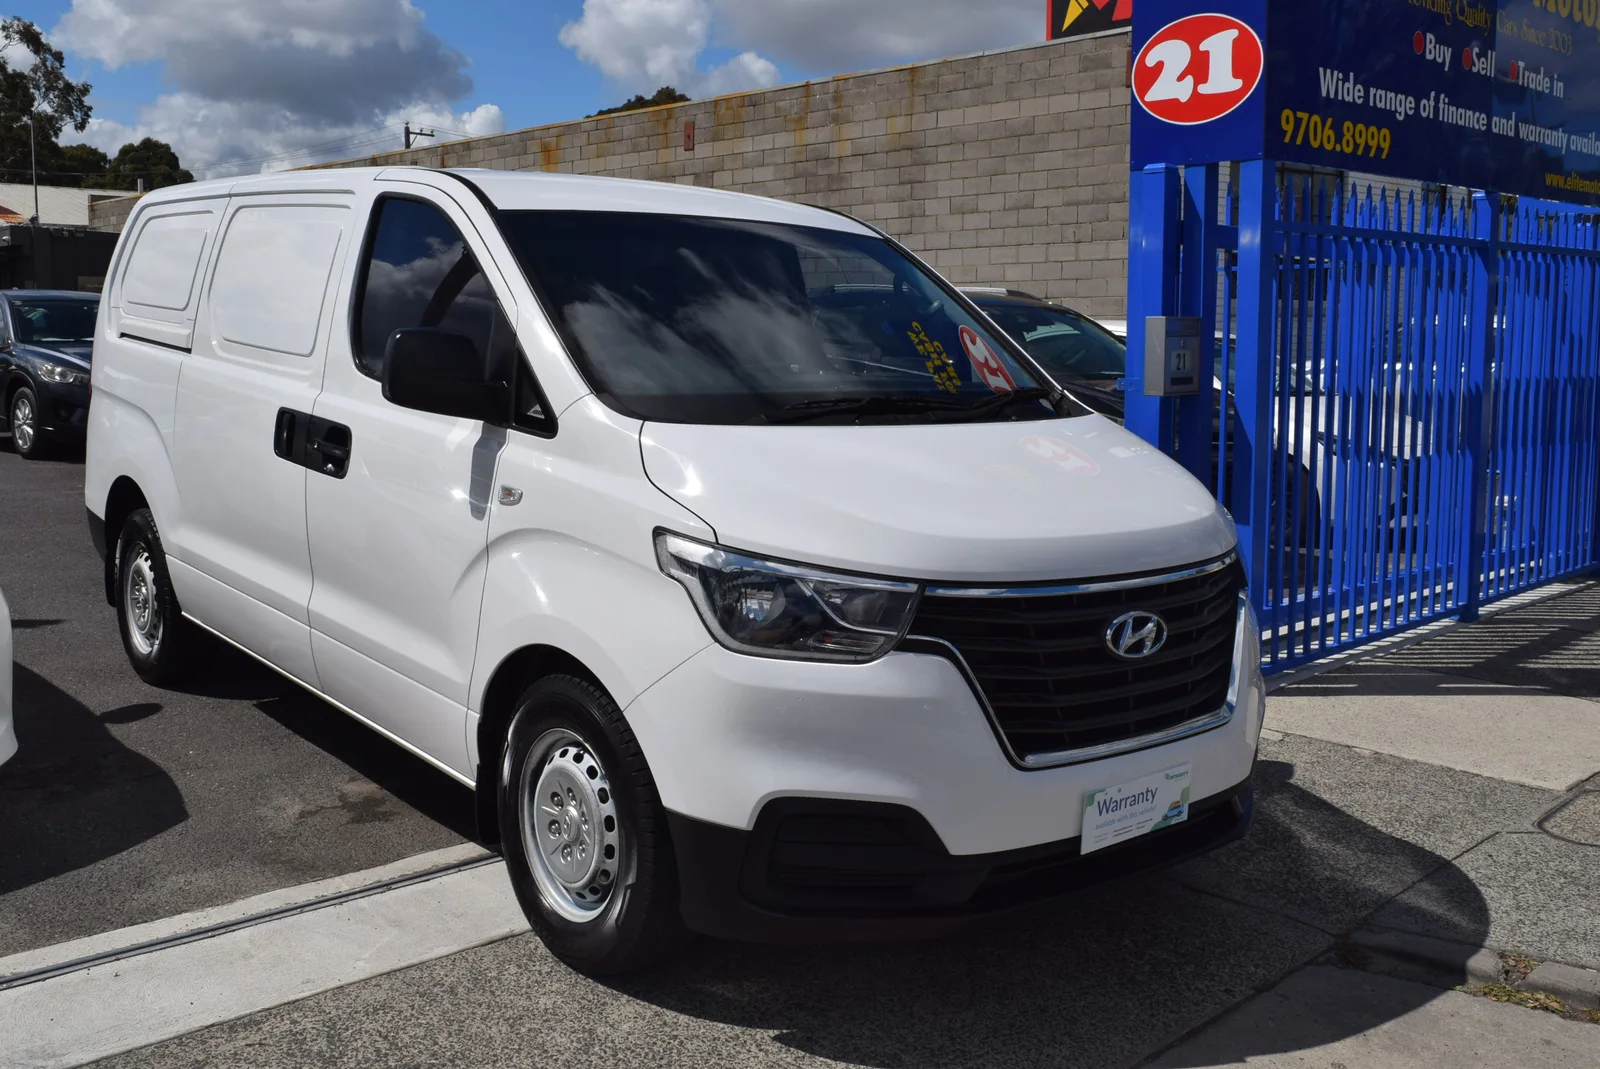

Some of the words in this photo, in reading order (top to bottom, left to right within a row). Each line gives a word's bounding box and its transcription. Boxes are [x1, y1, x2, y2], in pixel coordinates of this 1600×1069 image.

[1456, 0, 1492, 36] Quality
[1496, 9, 1518, 38] Cars
[1521, 18, 1546, 47] Since
[1549, 28, 1573, 55] 2003
[1144, 28, 1243, 102] 21
[1425, 33, 1452, 71] Buy
[1472, 46, 1495, 78] Sell
[1517, 61, 1551, 94] Trade
[1553, 75, 1565, 98] in
[1281, 109, 1391, 160] 9706.8999
[1319, 67, 1364, 104] Wide
[1369, 87, 1415, 121] range
[1420, 90, 1435, 120] of
[1438, 94, 1488, 131] finance
[1492, 112, 1515, 138] and
[1518, 122, 1568, 154] warranty
[1176, 352, 1186, 371] 21
[1097, 787, 1159, 817] Warranty
